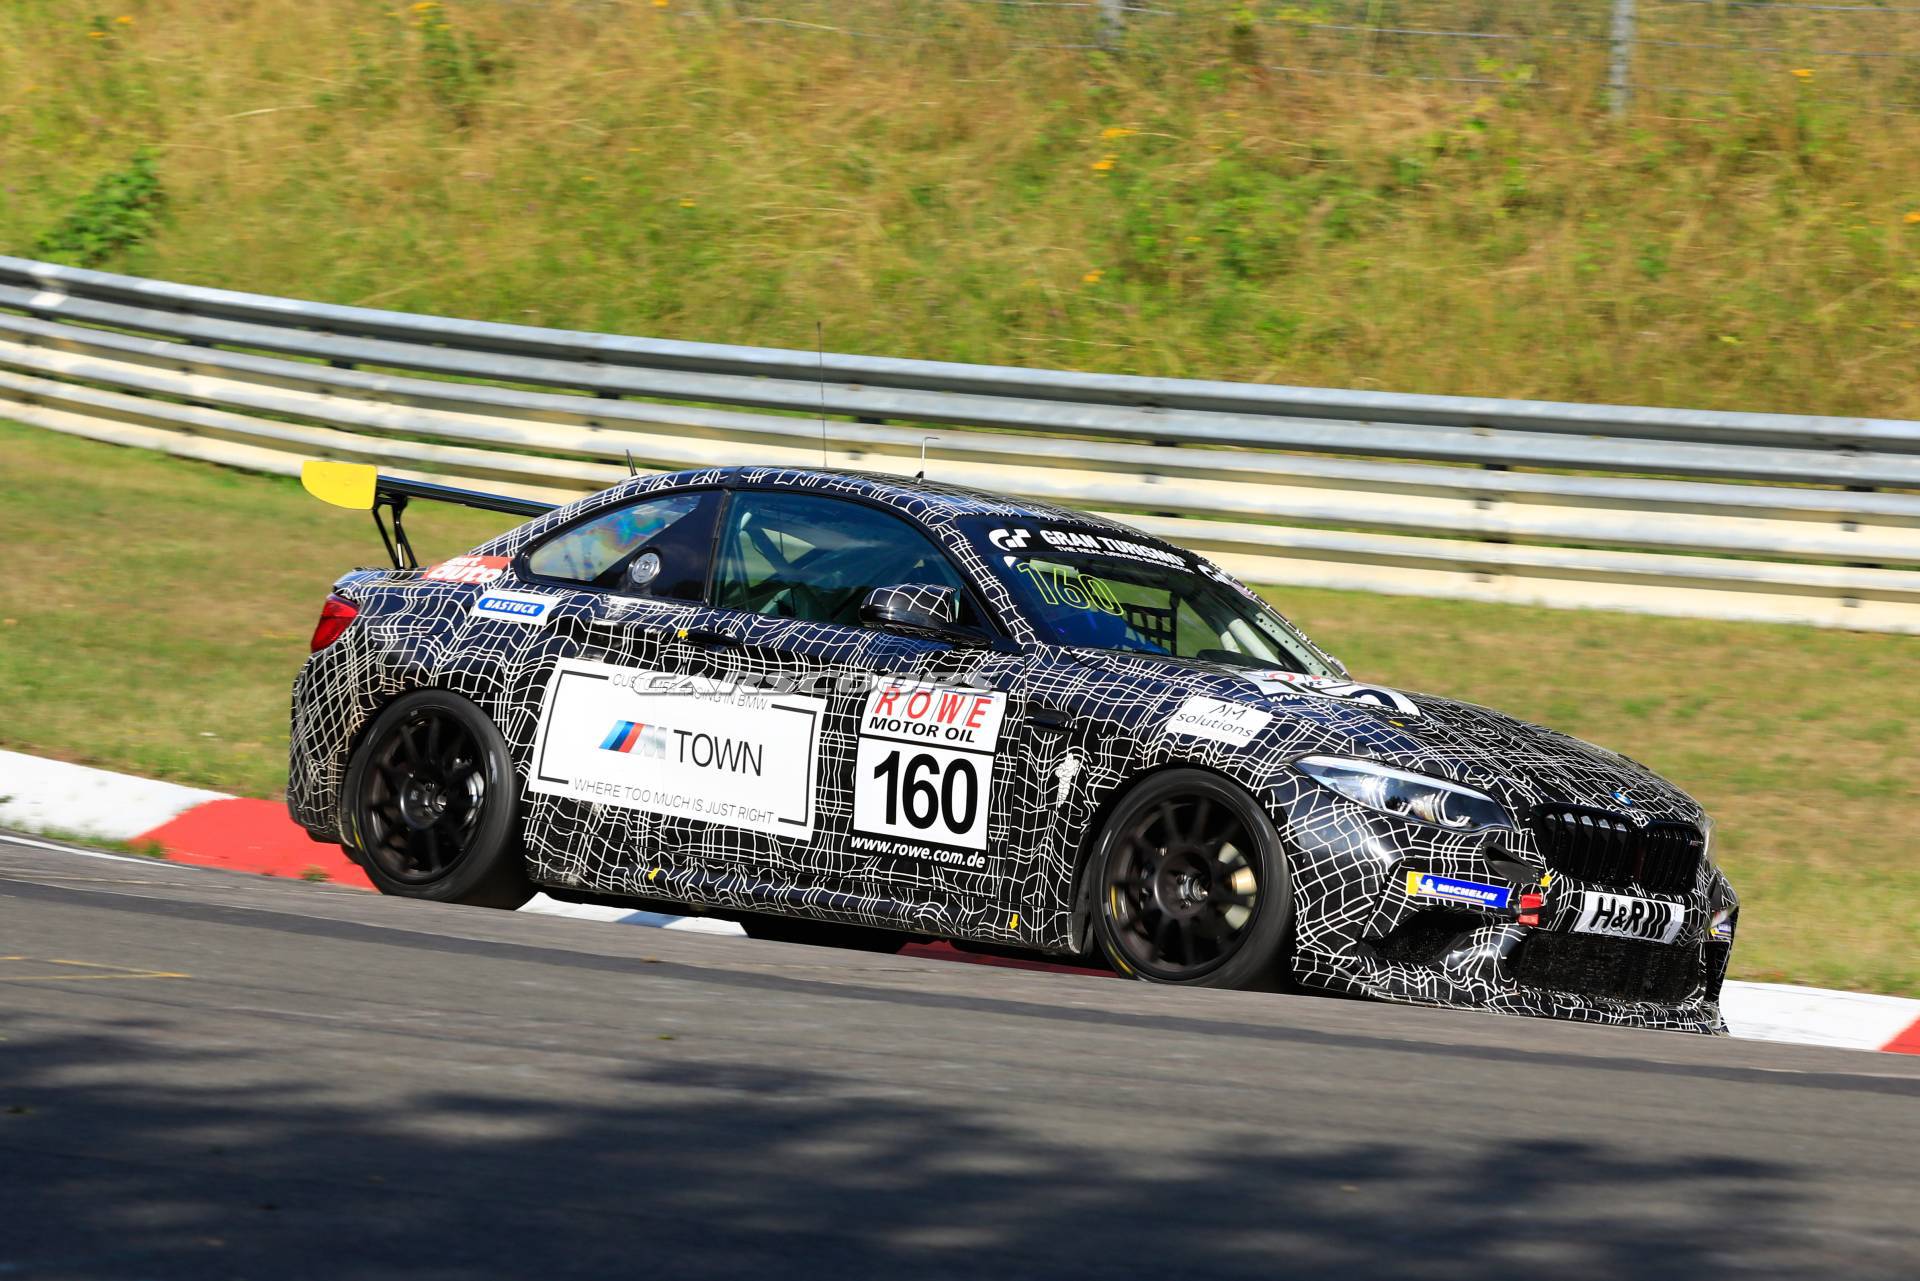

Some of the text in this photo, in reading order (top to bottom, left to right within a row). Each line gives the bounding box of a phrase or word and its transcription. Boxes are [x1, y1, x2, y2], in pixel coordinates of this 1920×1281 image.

[1040, 530, 1102, 549] GRAN
[1097, 536, 1187, 567] TURISMO
[426, 565, 503, 583] auto
[1017, 562, 1124, 616] 160
[484, 599, 539, 615] BASTUCK
[737, 694, 767, 710] BMW
[875, 686, 992, 729] ROWE
[869, 716, 976, 743] MOTOR OIL
[1176, 713, 1254, 738] solutions
[673, 729, 763, 777] TOWN
[574, 777, 775, 825] WHERE TOO MUCH IS JUST RIGHT
[873, 750, 979, 835] 160
[850, 836, 987, 869] www.rowe.com.de
[1436, 883, 1499, 901] MICHELIN
